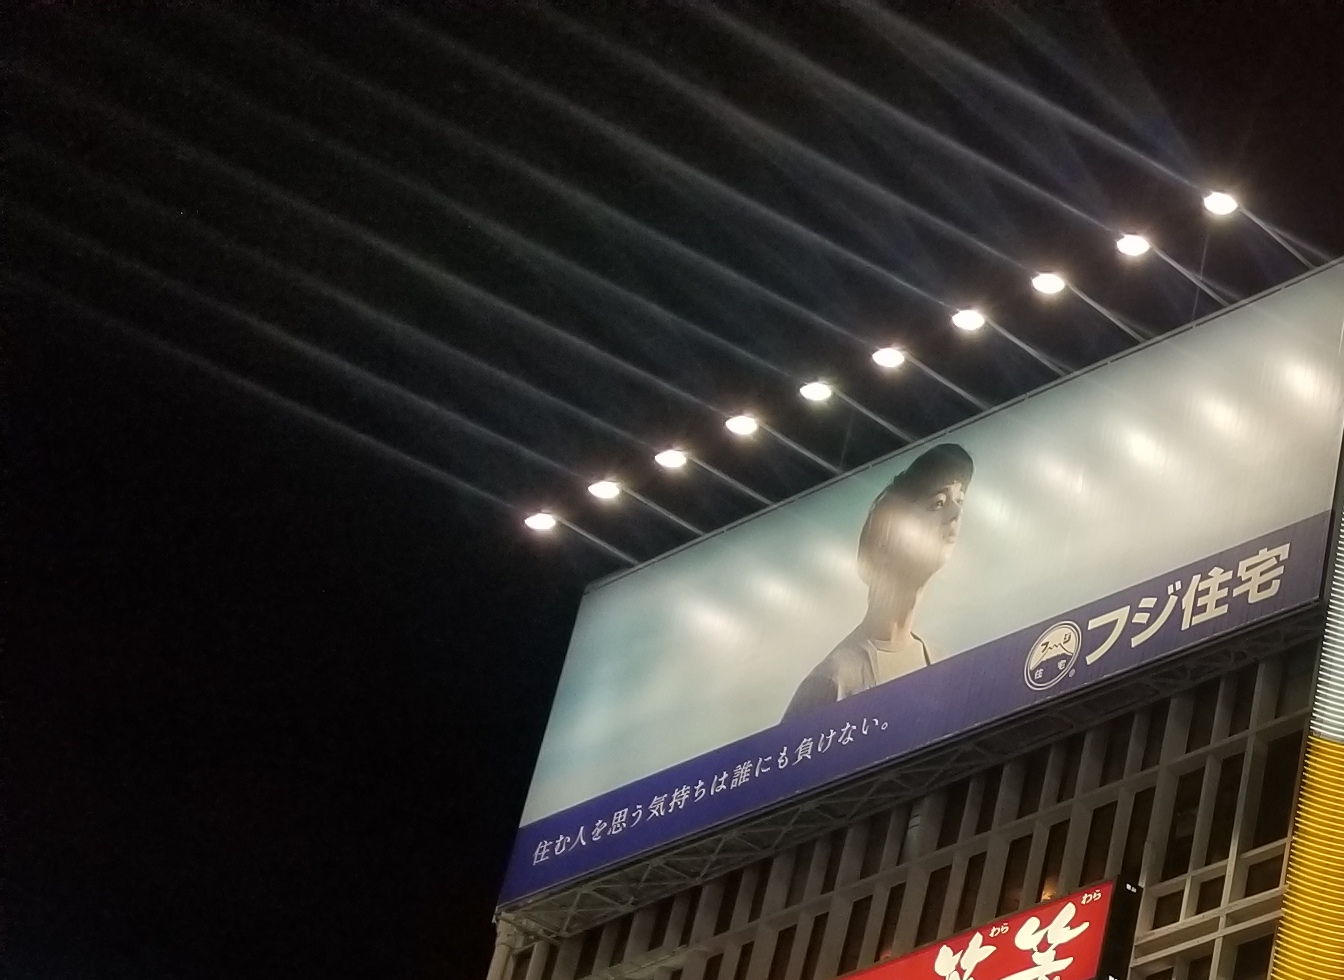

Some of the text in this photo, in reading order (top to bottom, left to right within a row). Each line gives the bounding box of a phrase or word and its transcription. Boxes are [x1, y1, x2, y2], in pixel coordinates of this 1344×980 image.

[1085, 543, 1291, 666] フジ住宅
[532, 717, 889, 866] 住む人を思う気持ちは誰にも負けない。
